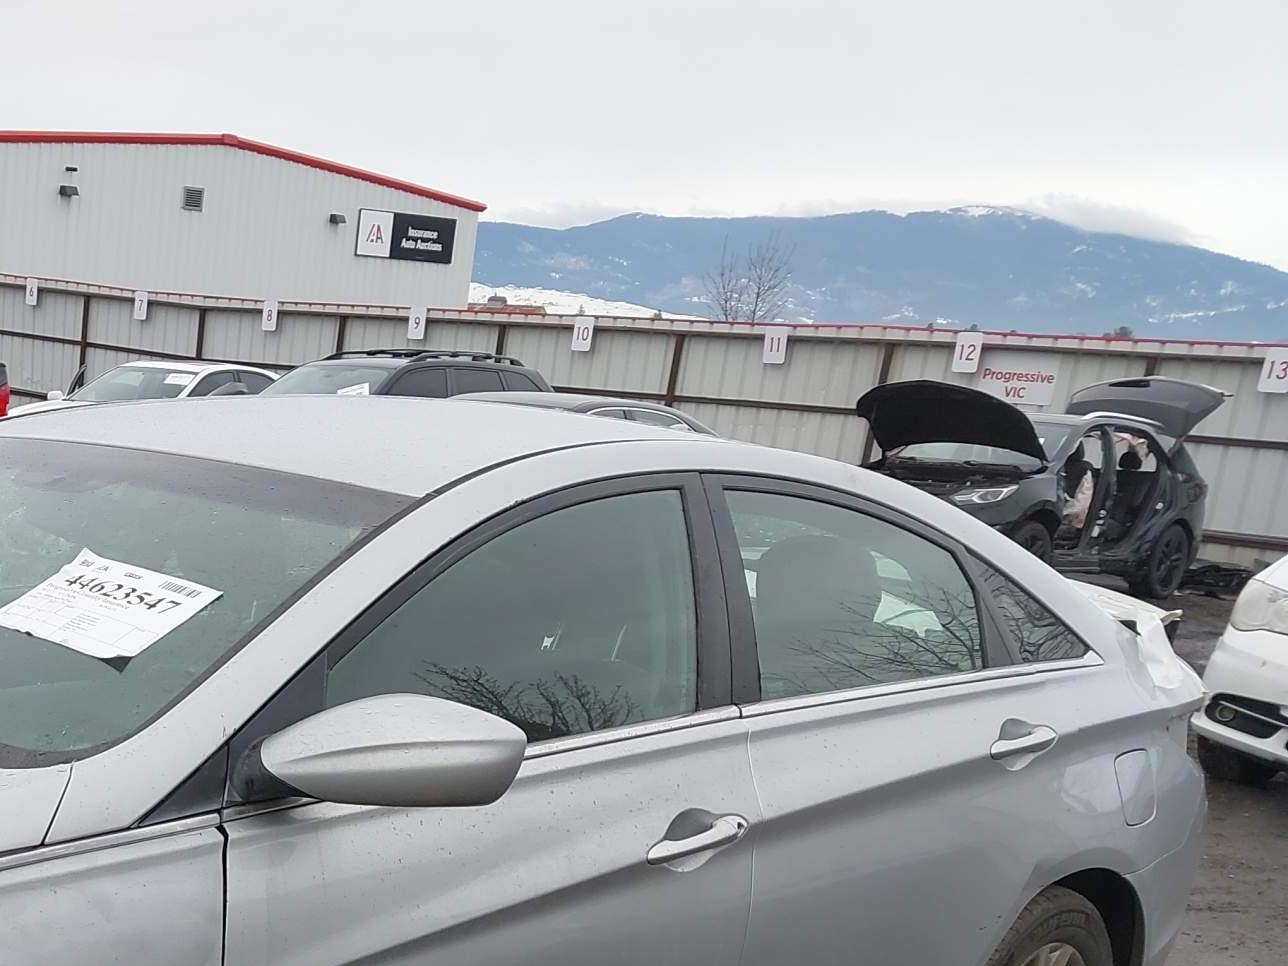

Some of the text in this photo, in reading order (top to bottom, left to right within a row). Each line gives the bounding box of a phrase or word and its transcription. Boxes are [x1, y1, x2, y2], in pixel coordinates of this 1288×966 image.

[400, 238, 416, 249] Auto
[29, 286, 34, 297] 6
[138, 299, 144, 312] 7
[266, 309, 272, 323] 8
[414, 316, 420, 330] 9
[576, 326, 589, 342] 10
[769, 336, 781, 353] 11
[959, 344, 976, 361] 12
[982, 368, 1055, 384] Progressive
[1267, 360, 1288, 380] 13
[1005, 386, 1026, 399] VIC
[64, 574, 183, 614] 44623547
